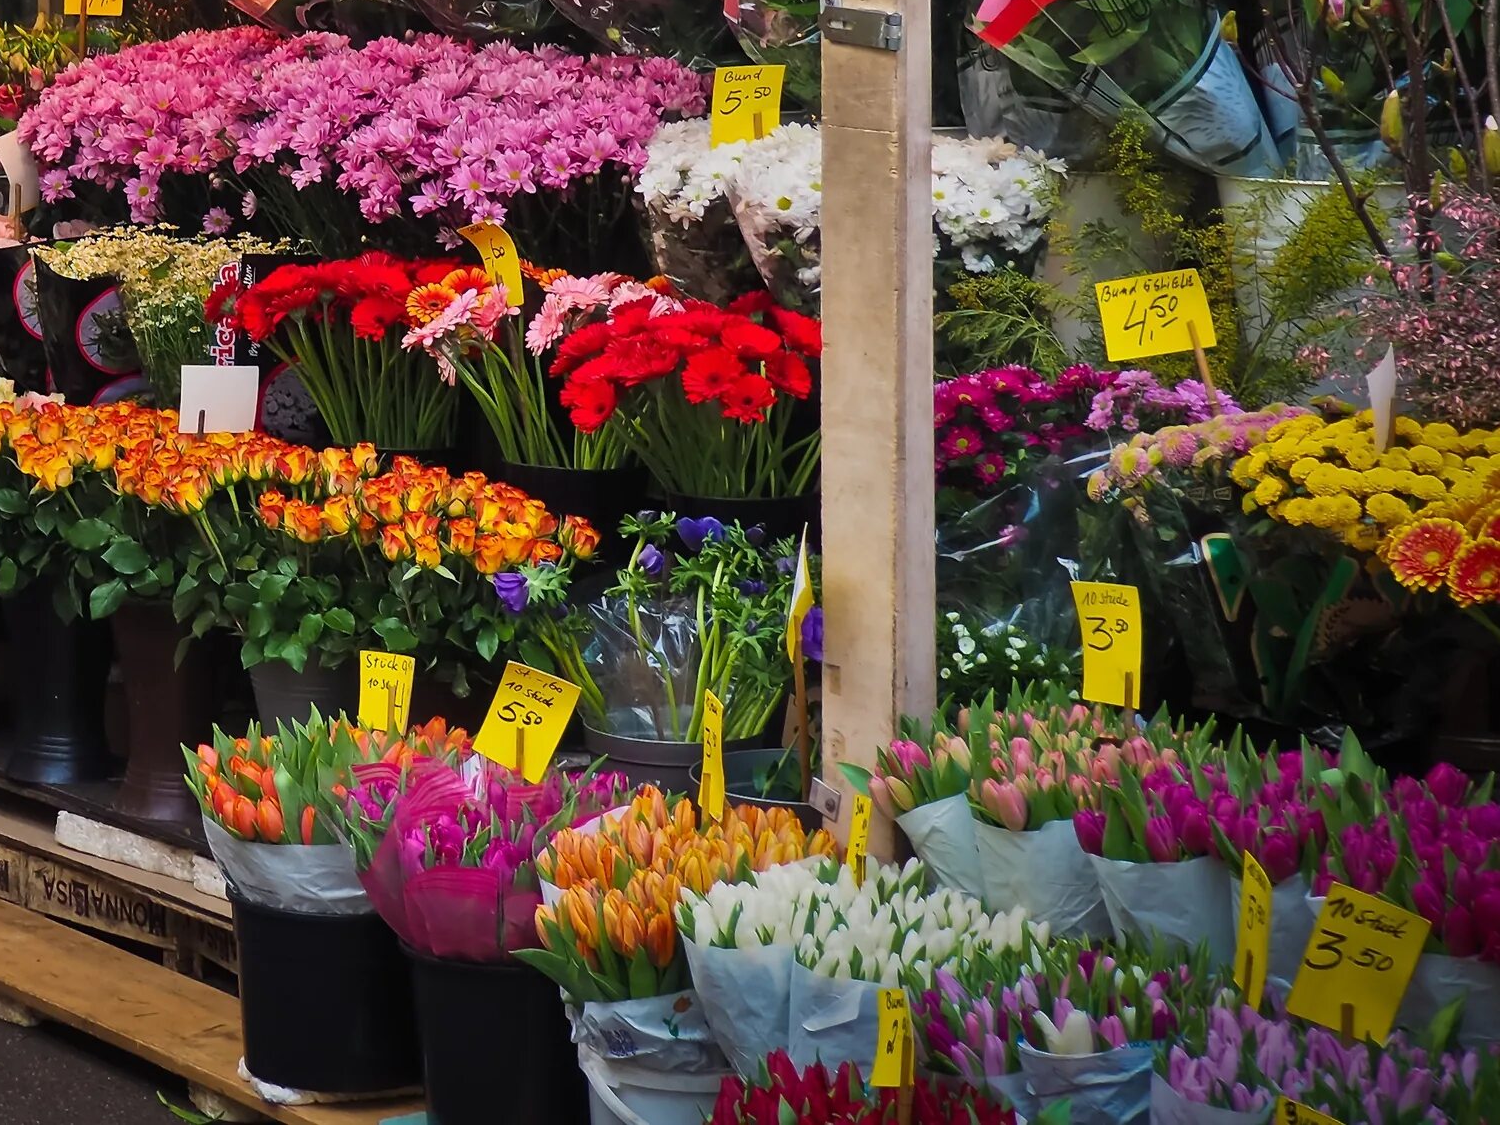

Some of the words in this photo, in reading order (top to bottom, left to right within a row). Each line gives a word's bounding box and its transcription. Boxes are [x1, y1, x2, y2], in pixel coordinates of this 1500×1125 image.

[723, 68, 762, 84] Bund
[1082, 591, 1097, 606] 10
[366, 654, 398, 672] Stück
[368, 678, 379, 689] 10
[505, 681, 523, 693] 10
[1327, 897, 1355, 920] 10
